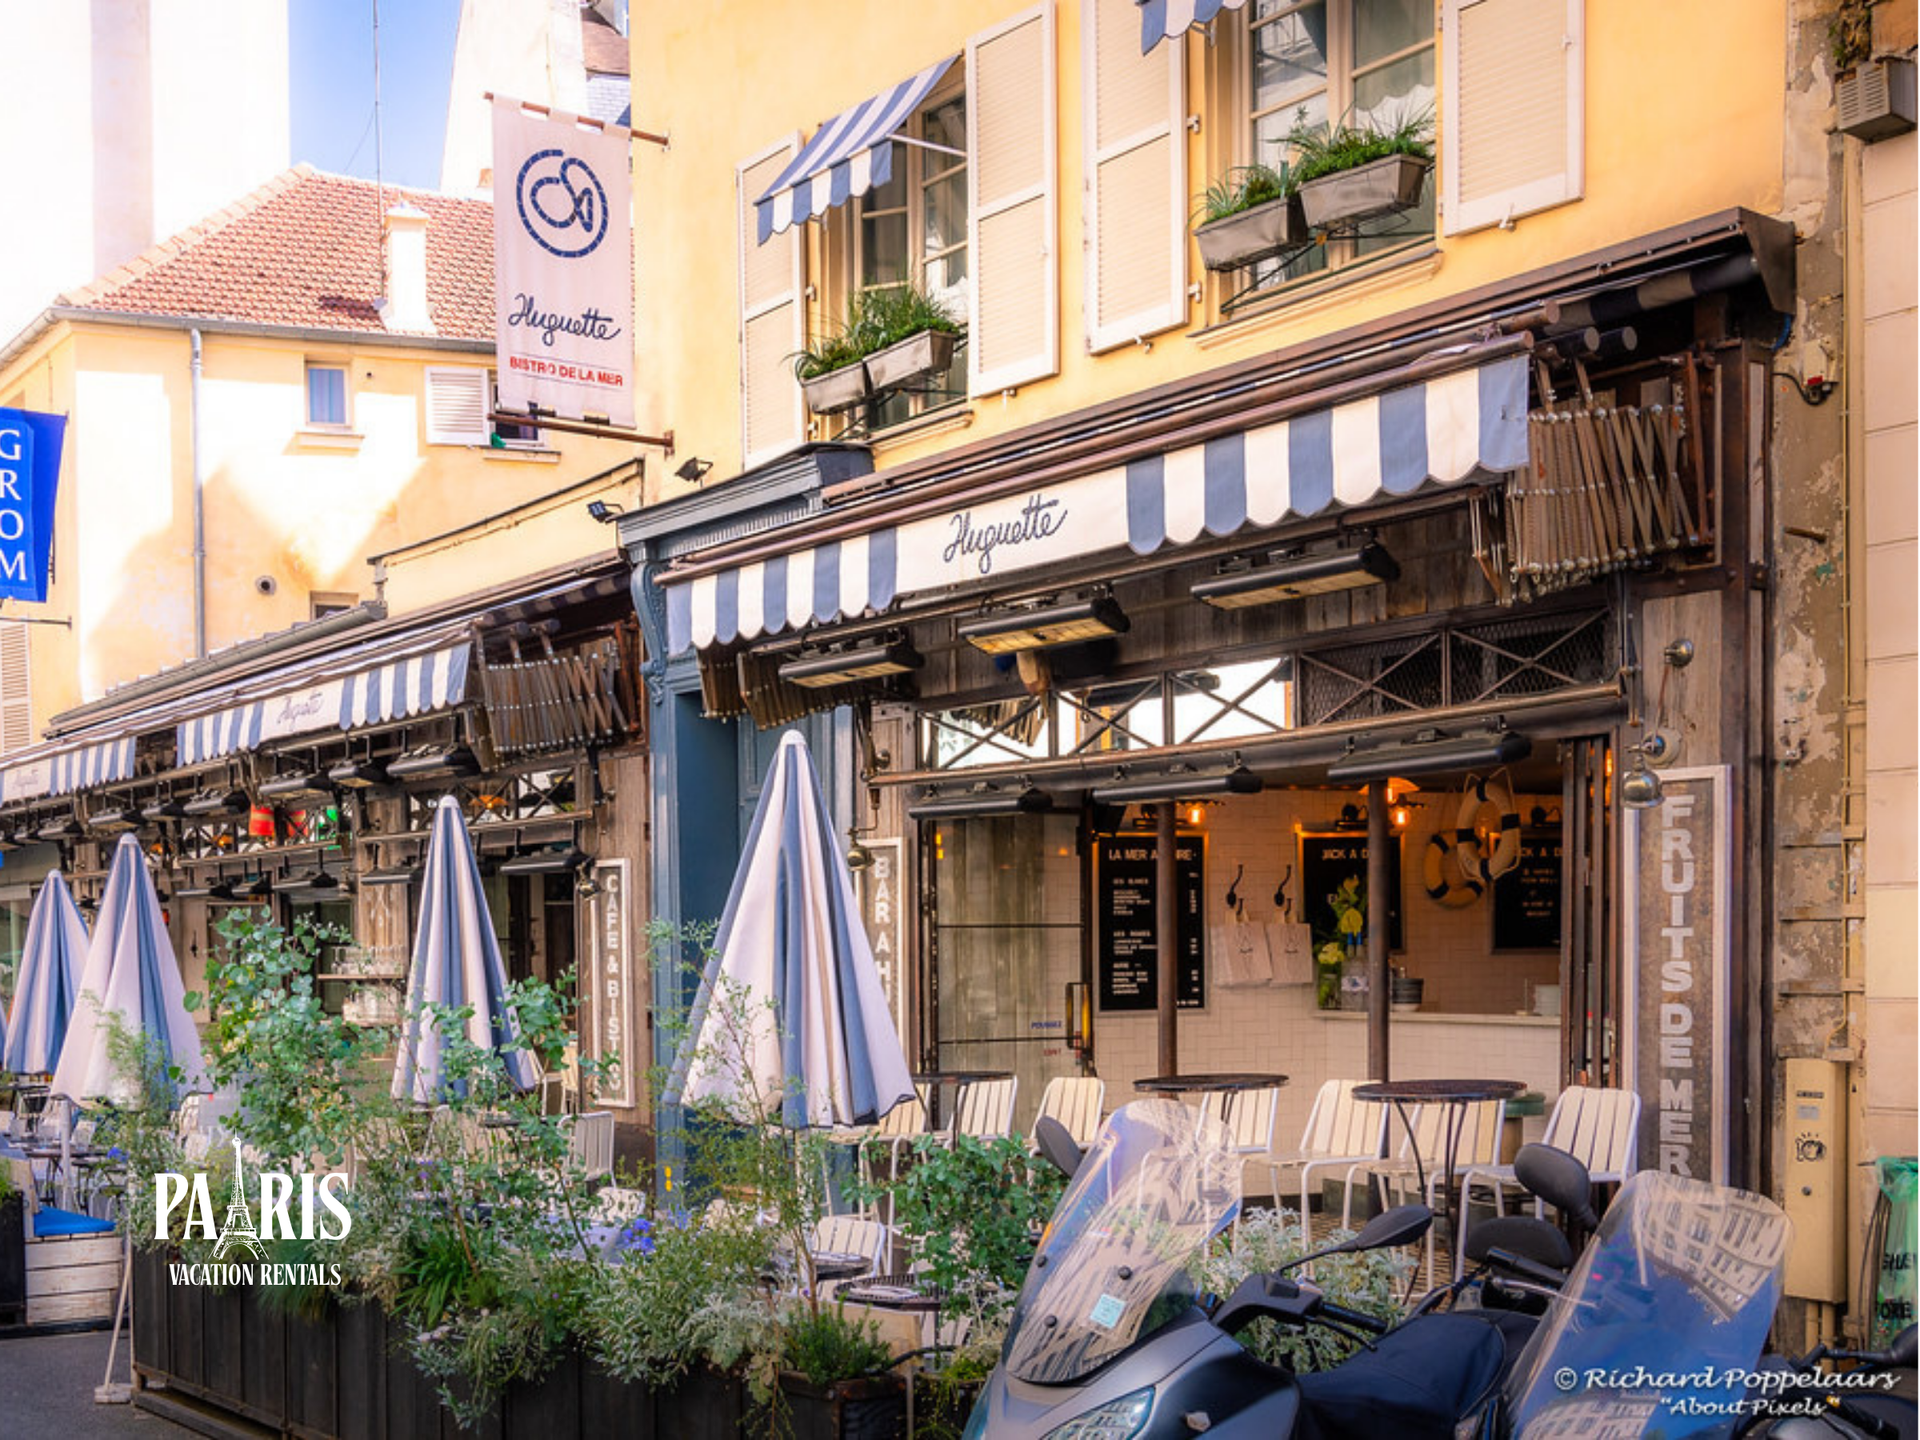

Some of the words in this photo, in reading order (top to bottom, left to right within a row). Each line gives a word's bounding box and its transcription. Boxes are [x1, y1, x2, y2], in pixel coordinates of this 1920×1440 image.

[508, 293, 622, 346] Huguette
[509, 355, 556, 375] BISTRO
[559, 364, 577, 380] DE
[578, 368, 596, 382] LA
[597, 371, 623, 387] MER
[0, 429, 27, 581] GROM
[943, 493, 1068, 574] Huguette
[606, 874, 619, 949] CAFE
[875, 855, 891, 924] BAR
[1660, 794, 1695, 993] FRUITS
[1659, 1003, 1694, 1068] DE
[1659, 1078, 1693, 1178] MER
